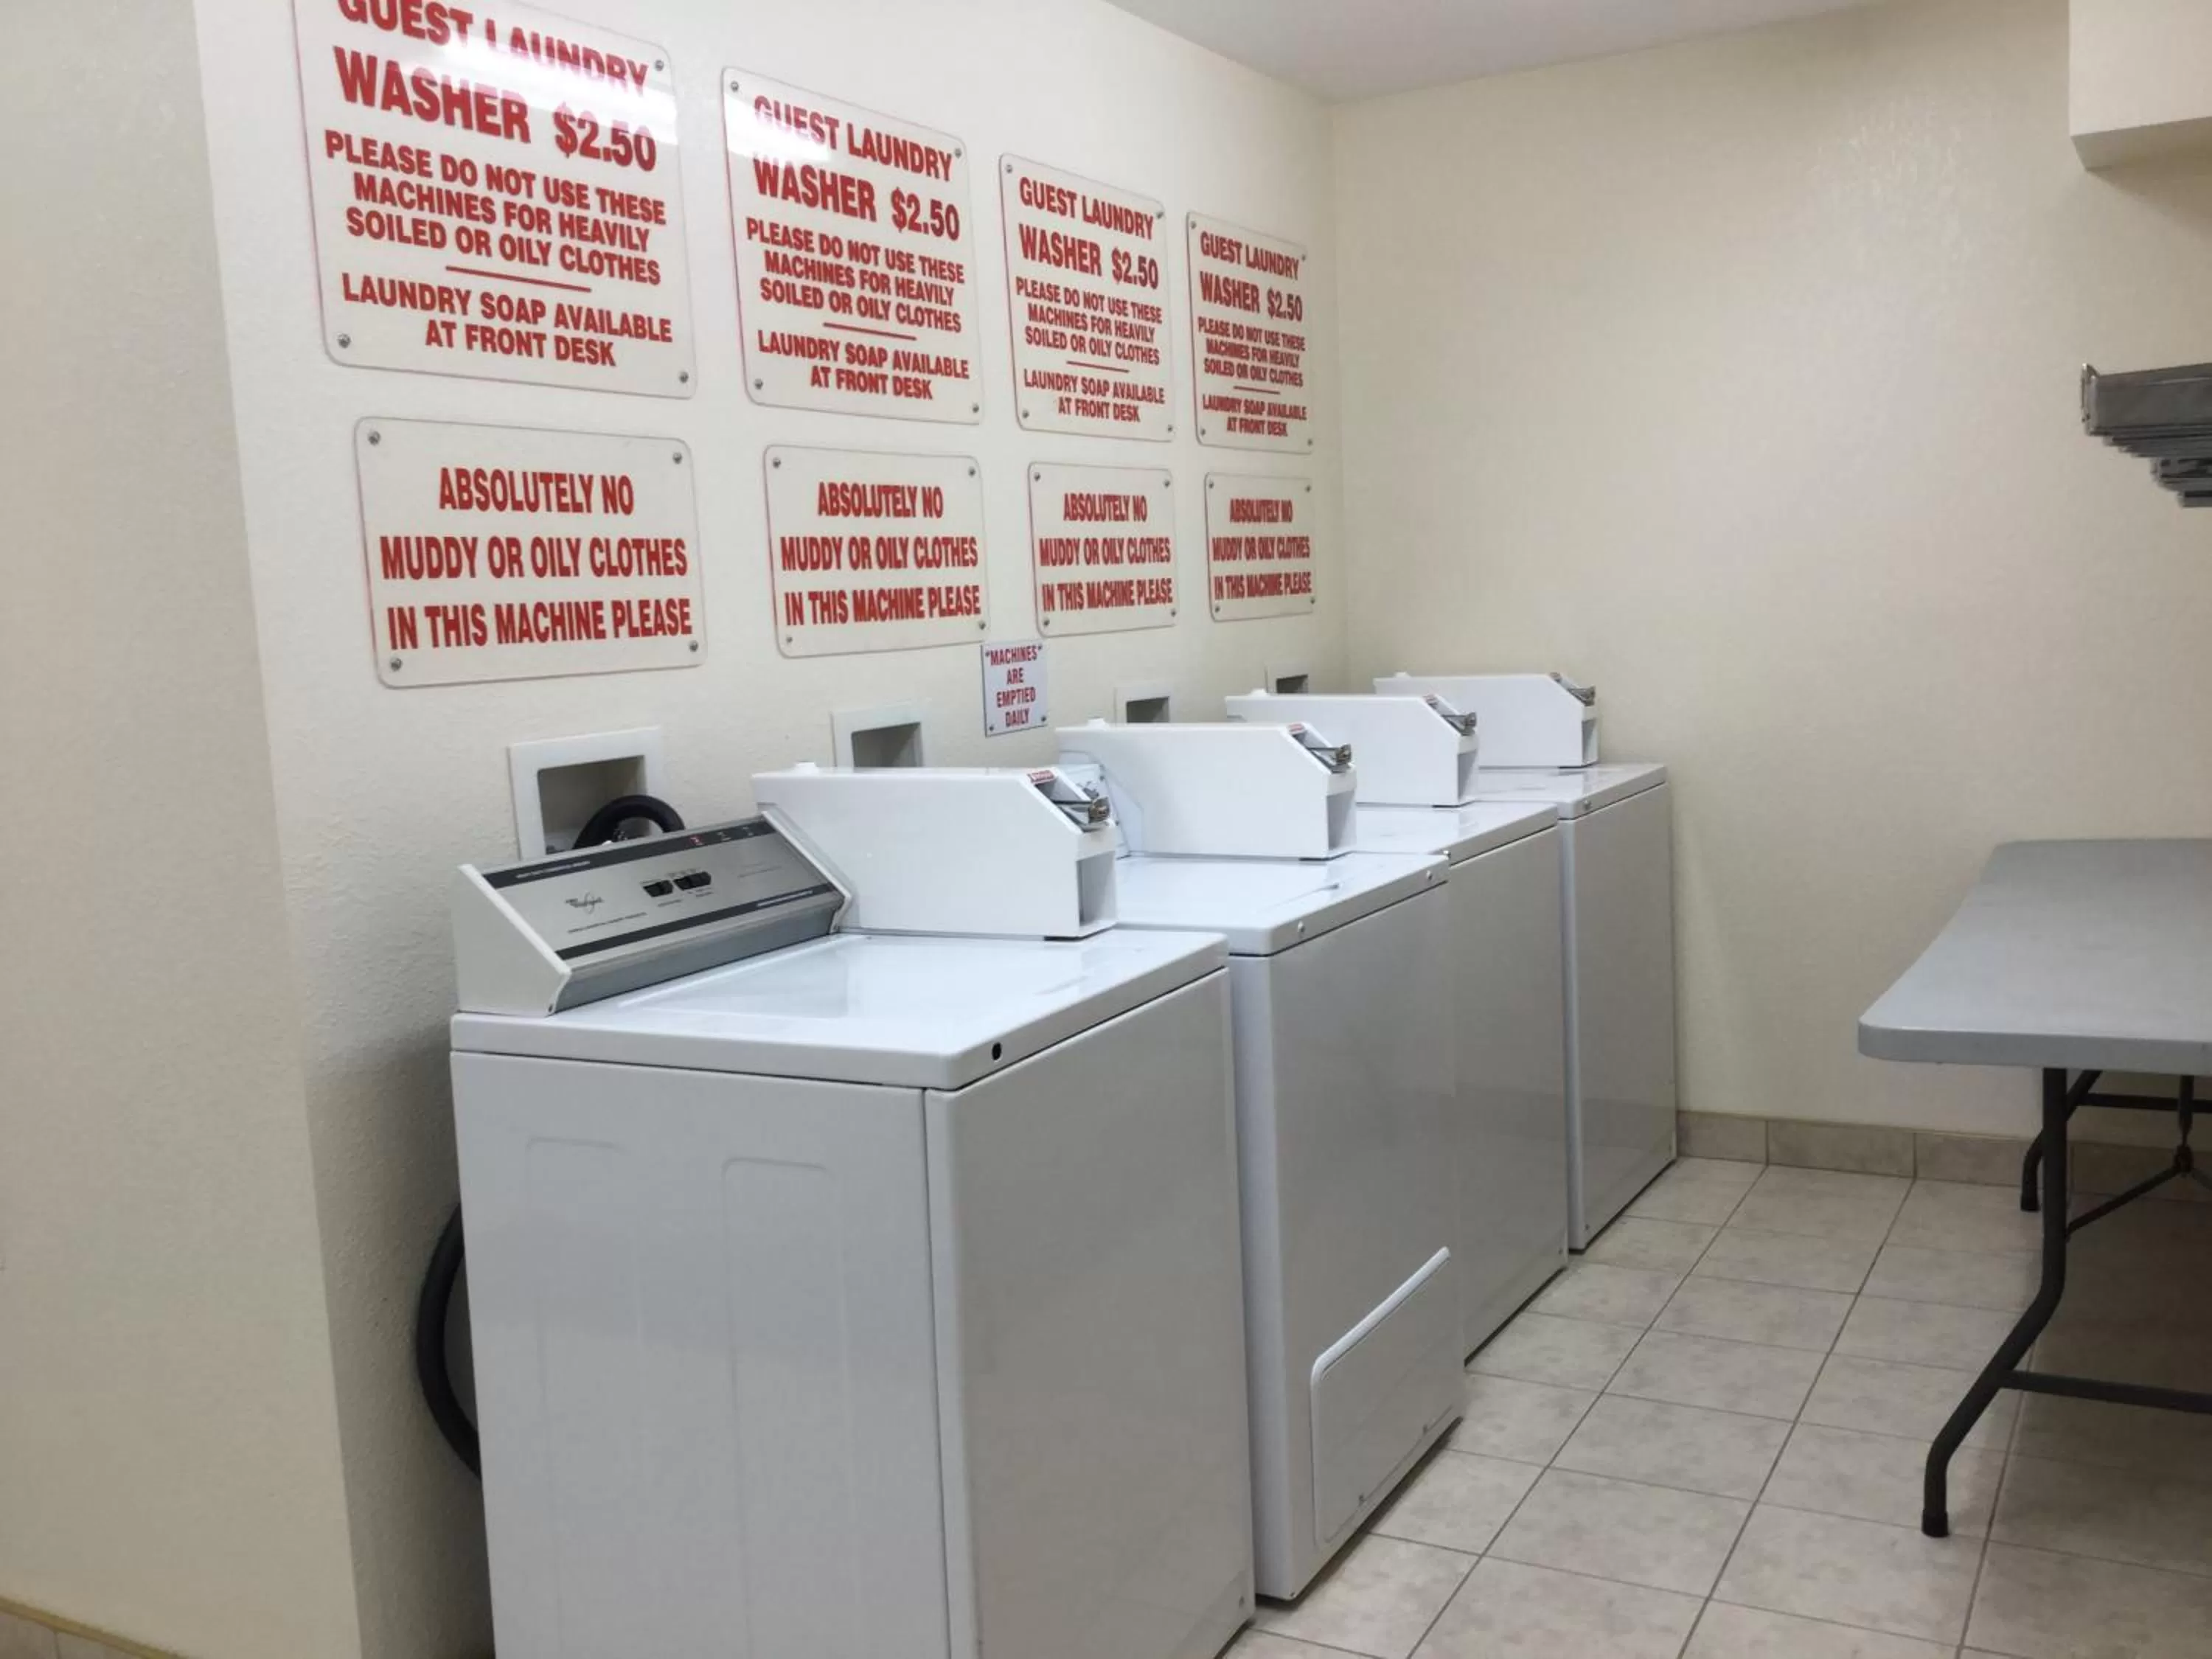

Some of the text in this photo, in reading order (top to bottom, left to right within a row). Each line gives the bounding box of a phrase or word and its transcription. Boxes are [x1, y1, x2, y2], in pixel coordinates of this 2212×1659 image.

[333, 46, 657, 172] WASHER $2.50
[847, 123, 952, 181] LAUNDRY
[325, 130, 666, 225] PLEASE DO NOT USE THESE
[753, 153, 959, 241] WASHER $2.50
[354, 172, 649, 252] MACHINES FOR HEAVILY
[1020, 177, 1153, 240] GUEST LAUNDRY
[347, 206, 661, 285] SOILED OR OILY CLOTHES
[746, 218, 964, 284] PLEASE DO NOT USE THESE
[1019, 223, 1158, 290] WASHER $2.50
[1200, 232, 1299, 280] GUEST LAUNDRY
[765, 250, 954, 307] MACHINES FOR HEAVILY
[1200, 271, 1303, 322] WASHER $2.50
[342, 273, 672, 343] LAUNDRY SOAP AVAILABLE
[760, 277, 961, 333] SOILED OR OILY CLOTHES
[1016, 276, 1162, 324] PLEASE DO NOT USE THESE
[425, 319, 616, 366] AT FRONT DESK
[1028, 303, 1155, 343] MACHINES FOR HEAVILY
[1197, 316, 1306, 352] PLEASE DO NOT USE THESE
[758, 330, 969, 379] LAUNDRY SOAP AVAILABLE
[1025, 325, 1160, 366] SOILED OR OILY CLOTHES
[1206, 338, 1300, 368] MACHINES FOR HEAVILY
[811, 365, 933, 400] AT FRONT DESK
[1024, 369, 1165, 404] LAUNDRY SOAP AVAILABLE
[1204, 358, 1304, 387] SOILED OR OILY CLOTHES
[1058, 397, 1140, 422] AT FRONT DESK
[1203, 394, 1307, 420] LAUNDRY SOAP AVAILABLE
[1227, 417, 1287, 437] AT FRONT DESK
[439, 467, 634, 515] ABSOLUTELY NO
[818, 482, 943, 518] ABSOLUTELY NO
[1063, 493, 1147, 522] ABSOLUTELY NO
[1230, 498, 1293, 524] ABSOLUTELY NO
[380, 536, 687, 580] MUDDY OR OILY CLOTHES
[781, 536, 978, 571] MUDDY OR OILY CLOTHES
[1039, 537, 1171, 566] MUDDY OR OILY CLOTHES
[1212, 536, 1310, 562] MUDDY OR OILY CLOTHES
[785, 585, 981, 626] IN THIS MACHINE PLEASE
[1042, 578, 1173, 611] IN THIS MACHINE PLEASE
[1214, 571, 1312, 599] IN THIS MACHINE PLEASE
[387, 598, 692, 650] IN THIS MACHINE PLEASE
[1006, 667, 1024, 684] ARE
[997, 686, 1036, 708] EMPTIED
[1006, 708, 1029, 727] DAILY
